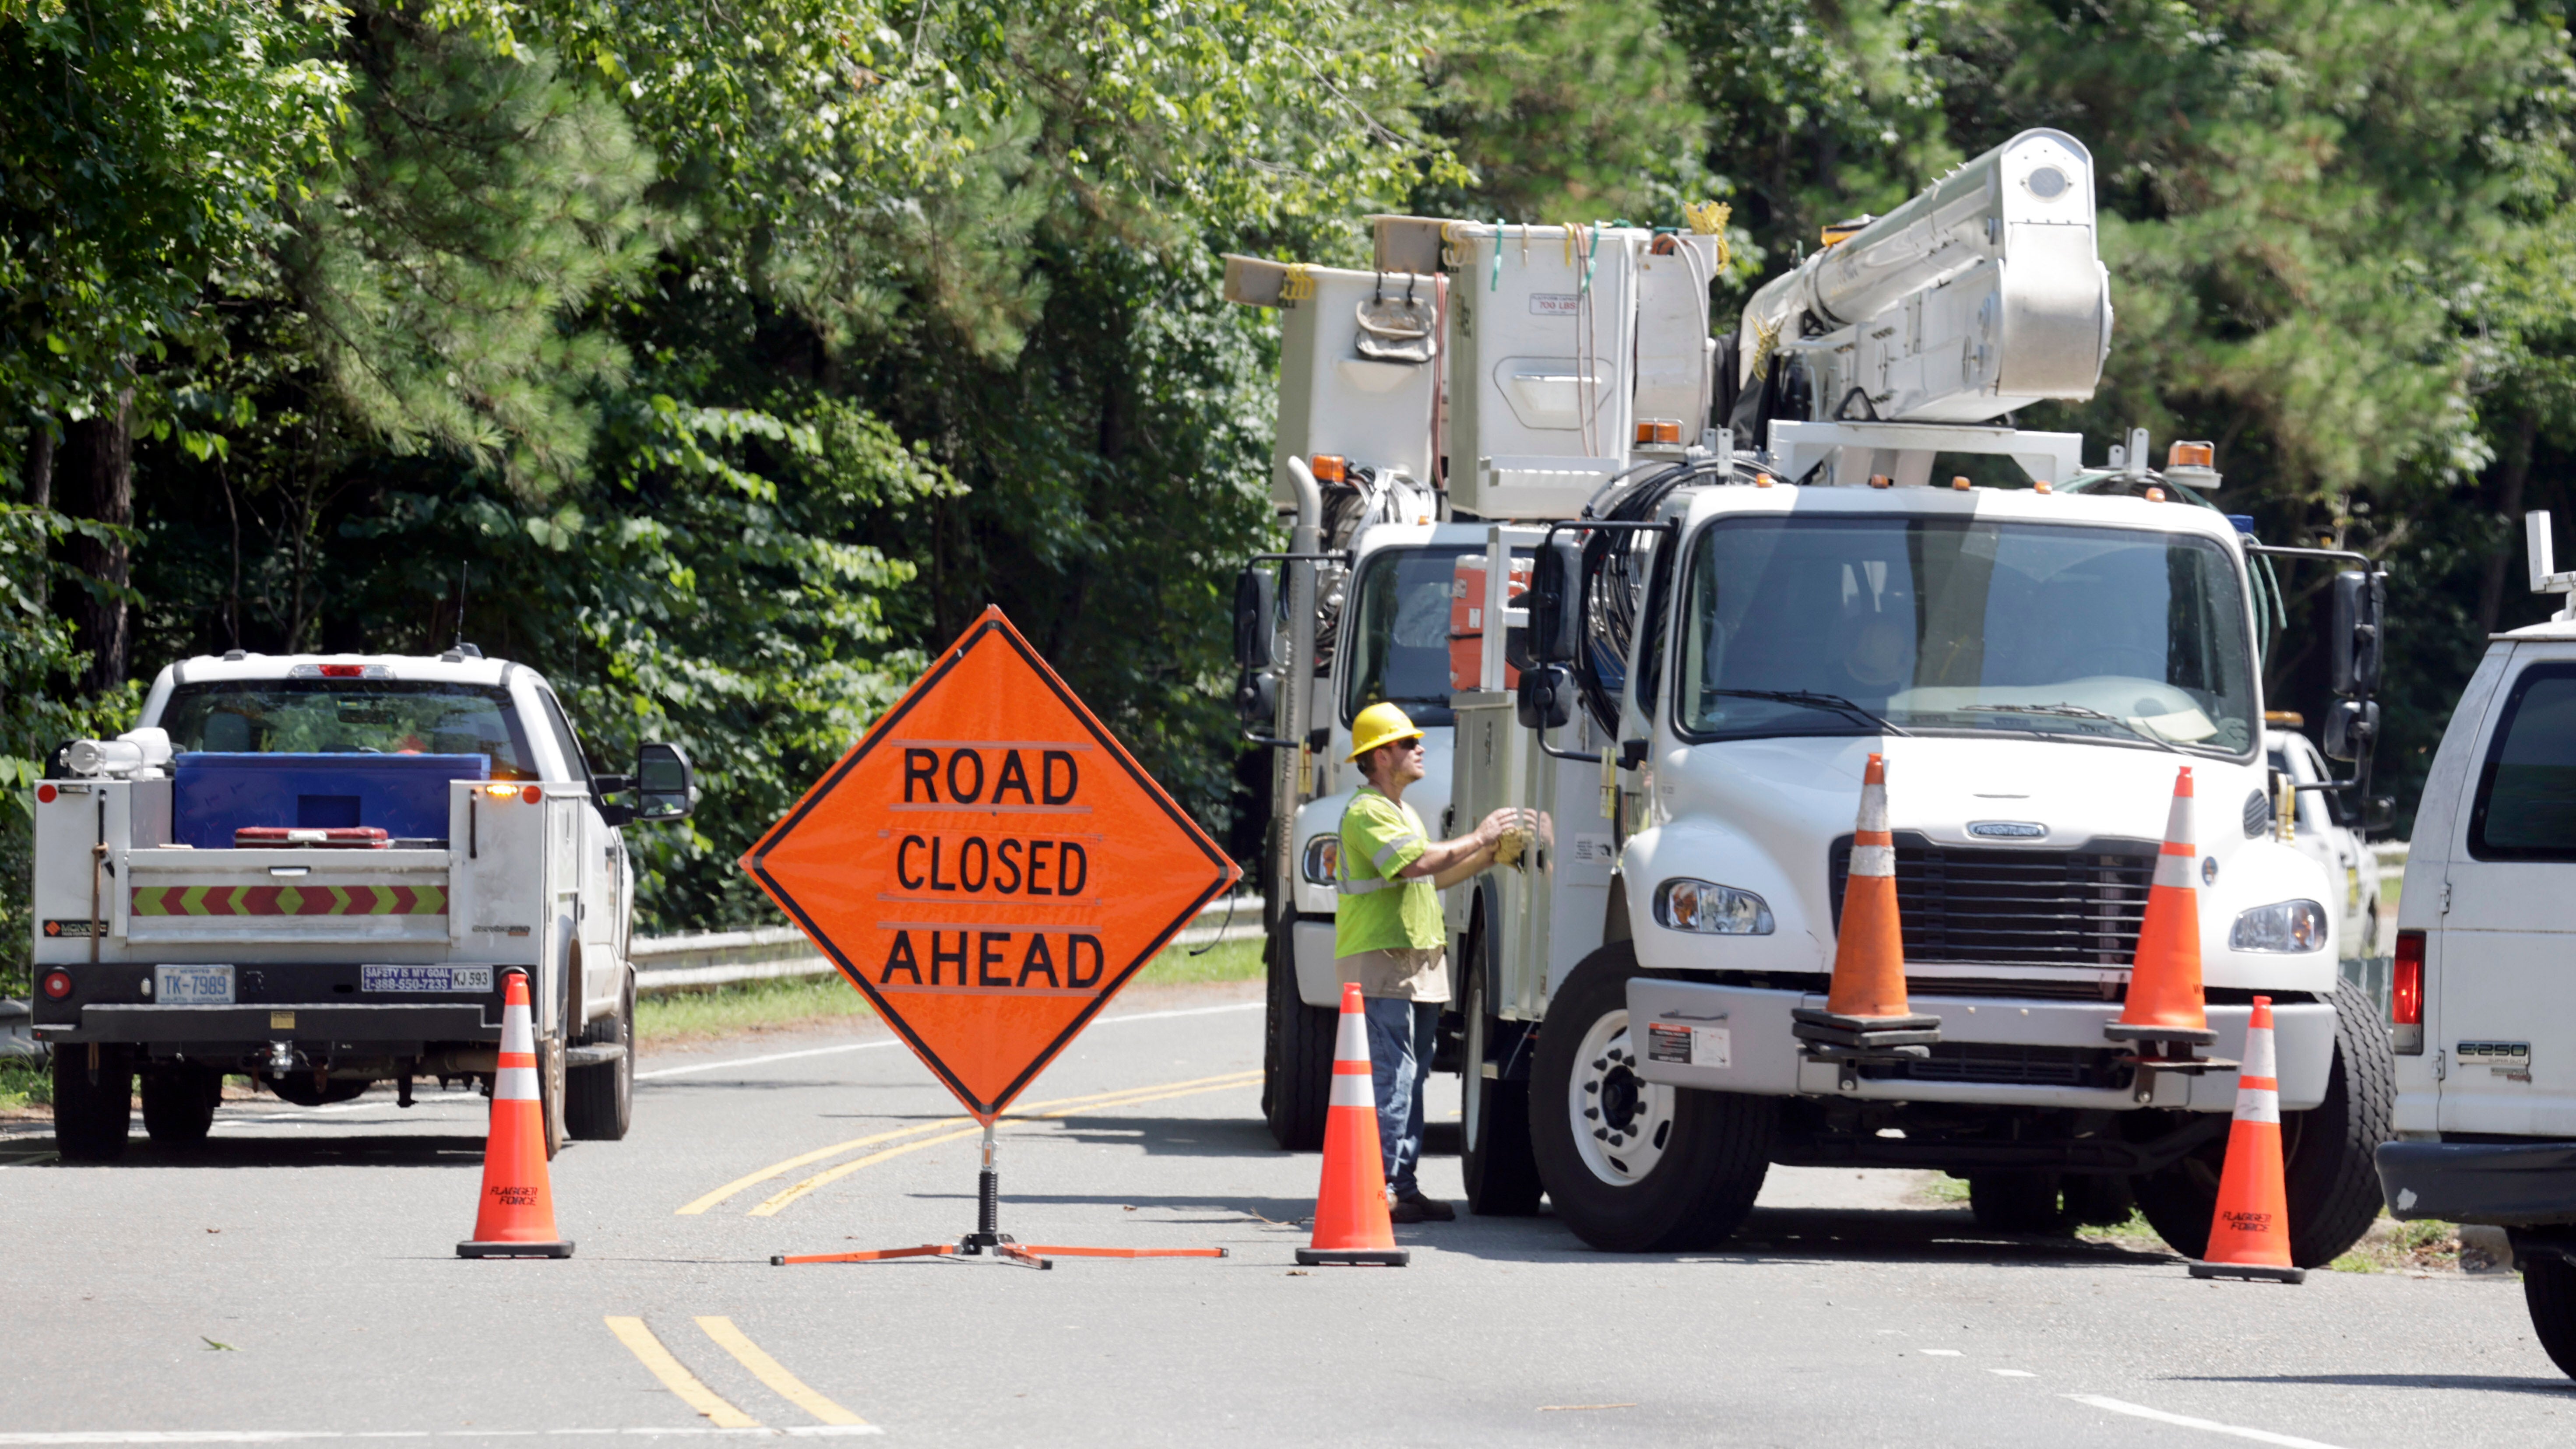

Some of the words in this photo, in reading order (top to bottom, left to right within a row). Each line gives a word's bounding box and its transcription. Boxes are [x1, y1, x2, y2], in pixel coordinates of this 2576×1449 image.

[1559, 302, 1576, 310] LBS
[904, 747, 1079, 805] ROAD
[897, 834, 1087, 897] CLOSED
[880, 930, 1105, 989] AHEAD
[365, 968, 399, 978] SAFETY
[401, 968, 409, 978] IS
[412, 968, 426, 978] MY
[426, 968, 450, 978] GOAL
[454, 972, 467, 986] KJ
[469, 971, 488, 985] 593
[165, 975, 226, 994] TK-7989
[365, 978, 448, 990] 1-888-550-7233
[2457, 1044, 2528, 1056] E-250
[490, 1186, 538, 1196] FLAGGER
[499, 1196, 537, 1206] FORCE
[2223, 1211, 2271, 1222] FLAGGER
[2231, 1222, 2269, 1231] FORCE
